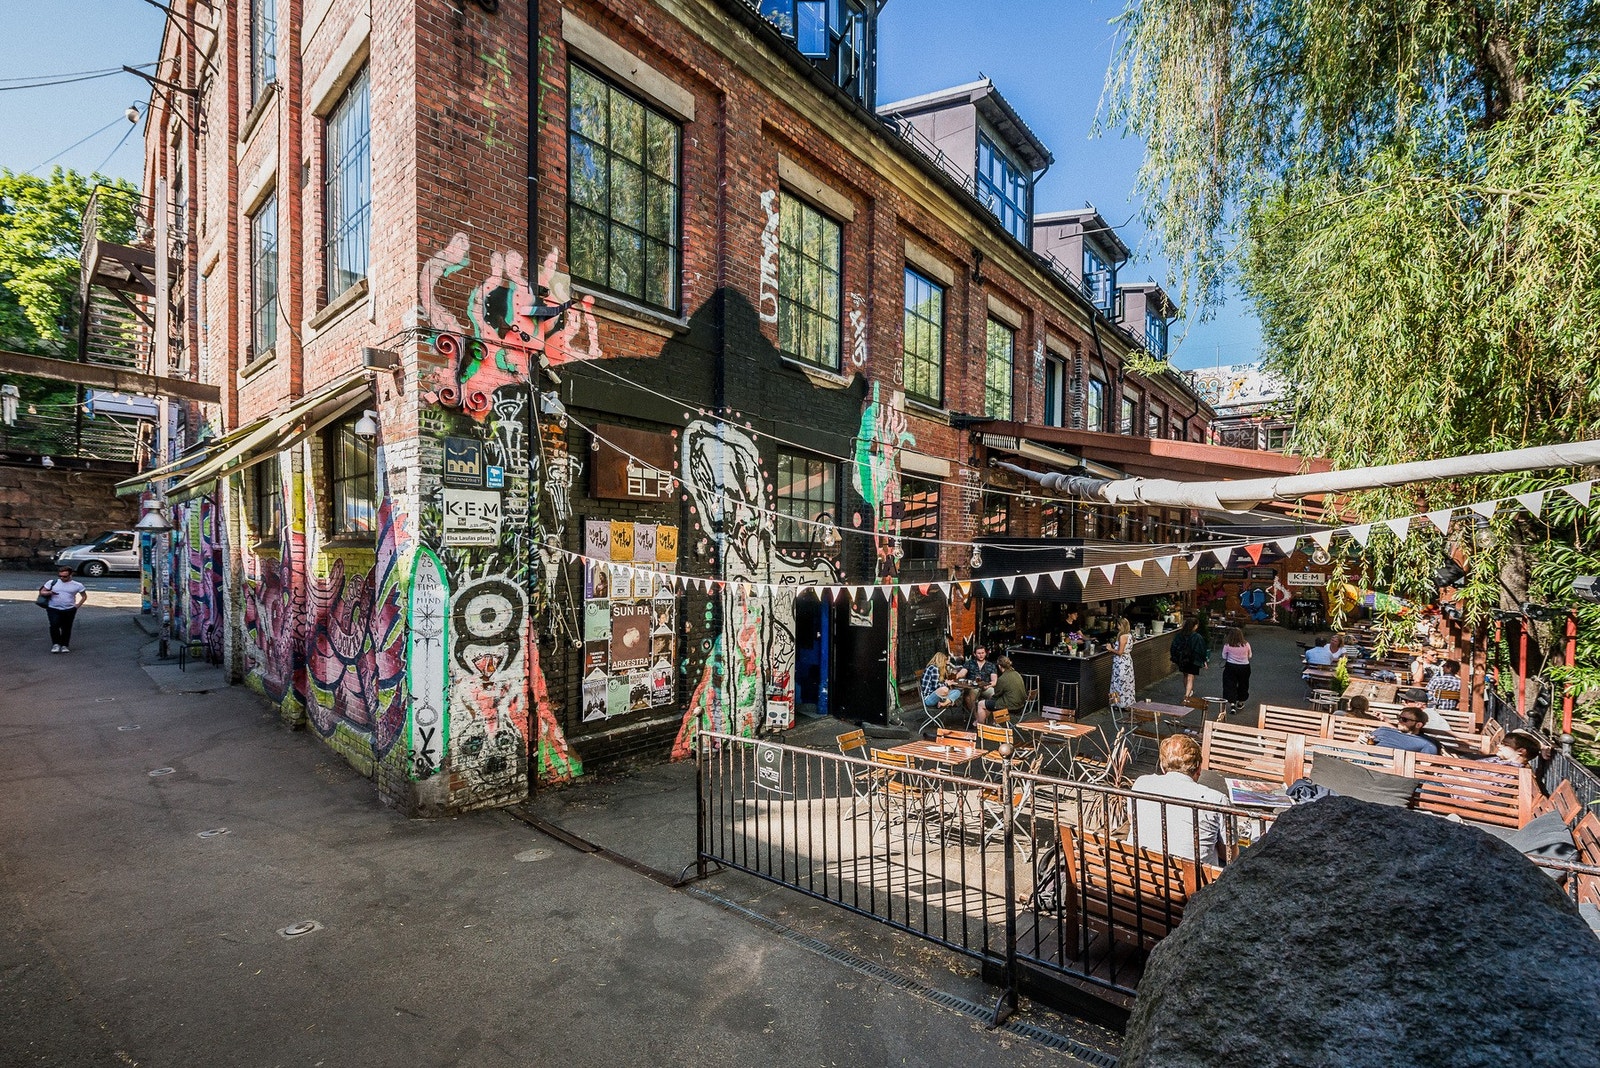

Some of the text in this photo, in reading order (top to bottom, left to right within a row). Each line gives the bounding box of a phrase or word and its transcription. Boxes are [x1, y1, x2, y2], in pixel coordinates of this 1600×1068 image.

[613, 605, 650, 617] SUN RA
[612, 657, 649, 668] ARKESTRA
